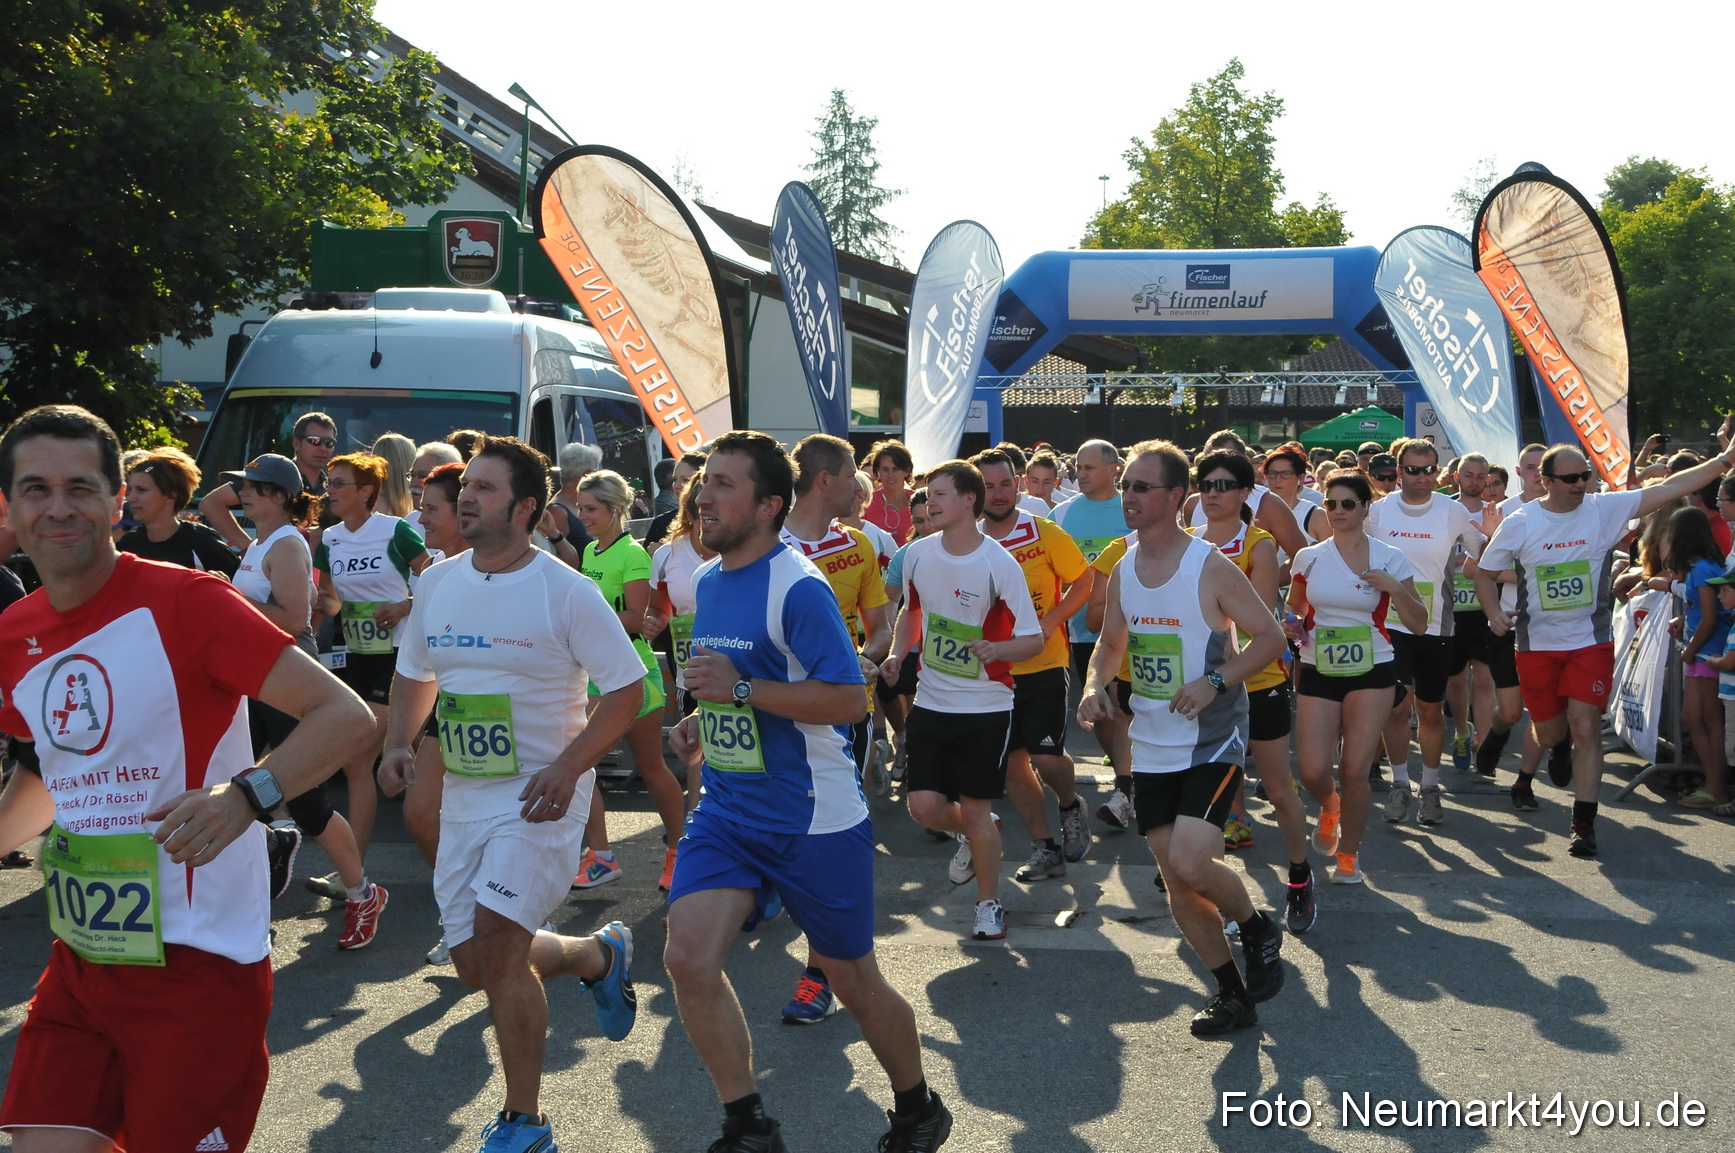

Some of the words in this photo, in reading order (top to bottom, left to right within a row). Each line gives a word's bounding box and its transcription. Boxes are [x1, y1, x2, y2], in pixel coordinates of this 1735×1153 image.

[460, 270, 485, 281] 1628
[1169, 290, 1268, 309] firmenlauf
[935, 251, 983, 382] Fischer
[991, 324, 1036, 335] ischer
[347, 557, 382, 572] RSC
[826, 553, 864, 574] BÖGL
[1015, 546, 1045, 563] ÖGL
[1546, 577, 1583, 599] 559
[344, 620, 389, 641] 1198
[1141, 617, 1182, 627] KLEBL
[492, 636, 534, 649] energie
[676, 641, 692, 663] 50
[933, 636, 971, 664] 124
[1324, 643, 1364, 664] 120
[1132, 654, 1172, 683] 555
[441, 720, 511, 757] 1186
[700, 708, 756, 751] 1258
[82, 771, 110, 786] MIT
[116, 766, 160, 783] HERZ
[90, 795, 104, 806] Dr.
[106, 791, 148, 804] Röschl
[64, 812, 148, 832] ungsdiagnostik
[48, 870, 154, 932] 1022
